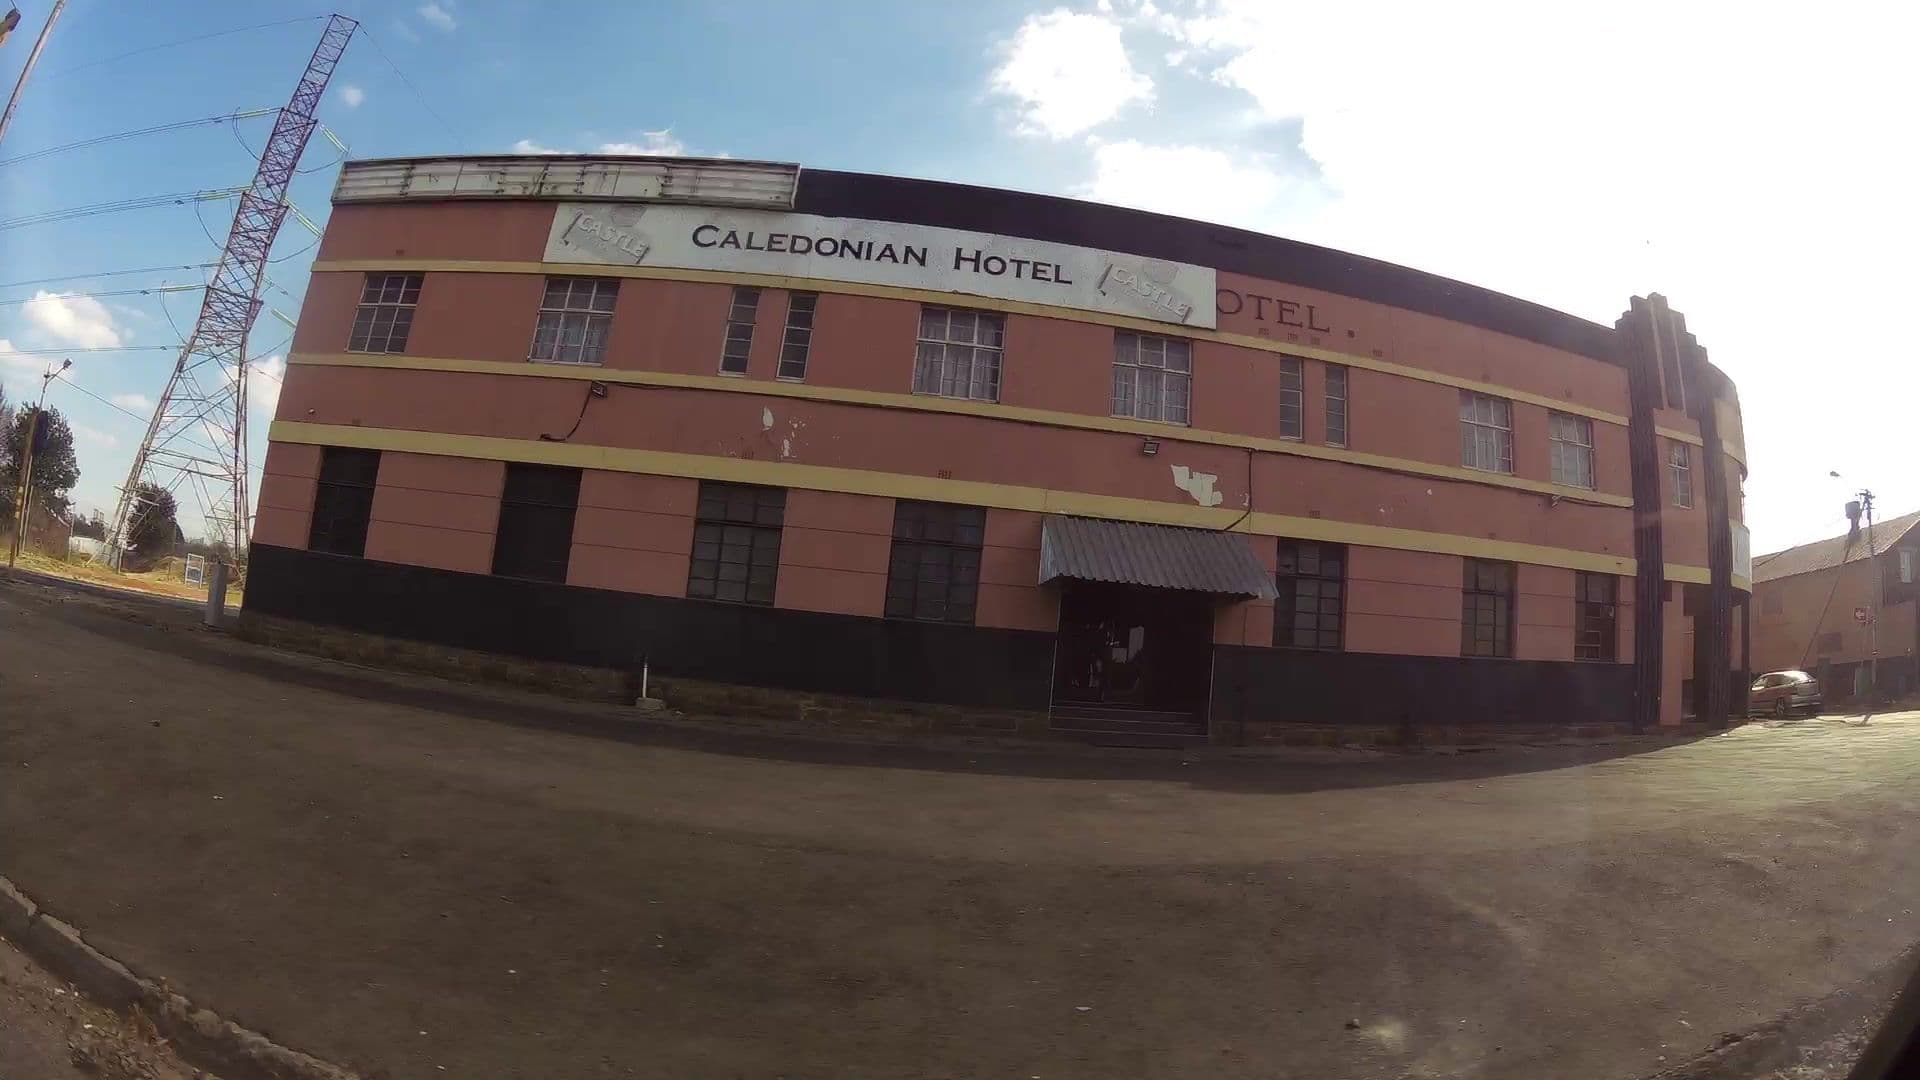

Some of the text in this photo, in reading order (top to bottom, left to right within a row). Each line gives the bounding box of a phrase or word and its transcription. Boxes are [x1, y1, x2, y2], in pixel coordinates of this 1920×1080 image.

[578, 214, 647, 258] CASTLE
[692, 224, 1073, 285] CALEDONIAN HOTEL
[1112, 268, 1189, 318] CASTLE
